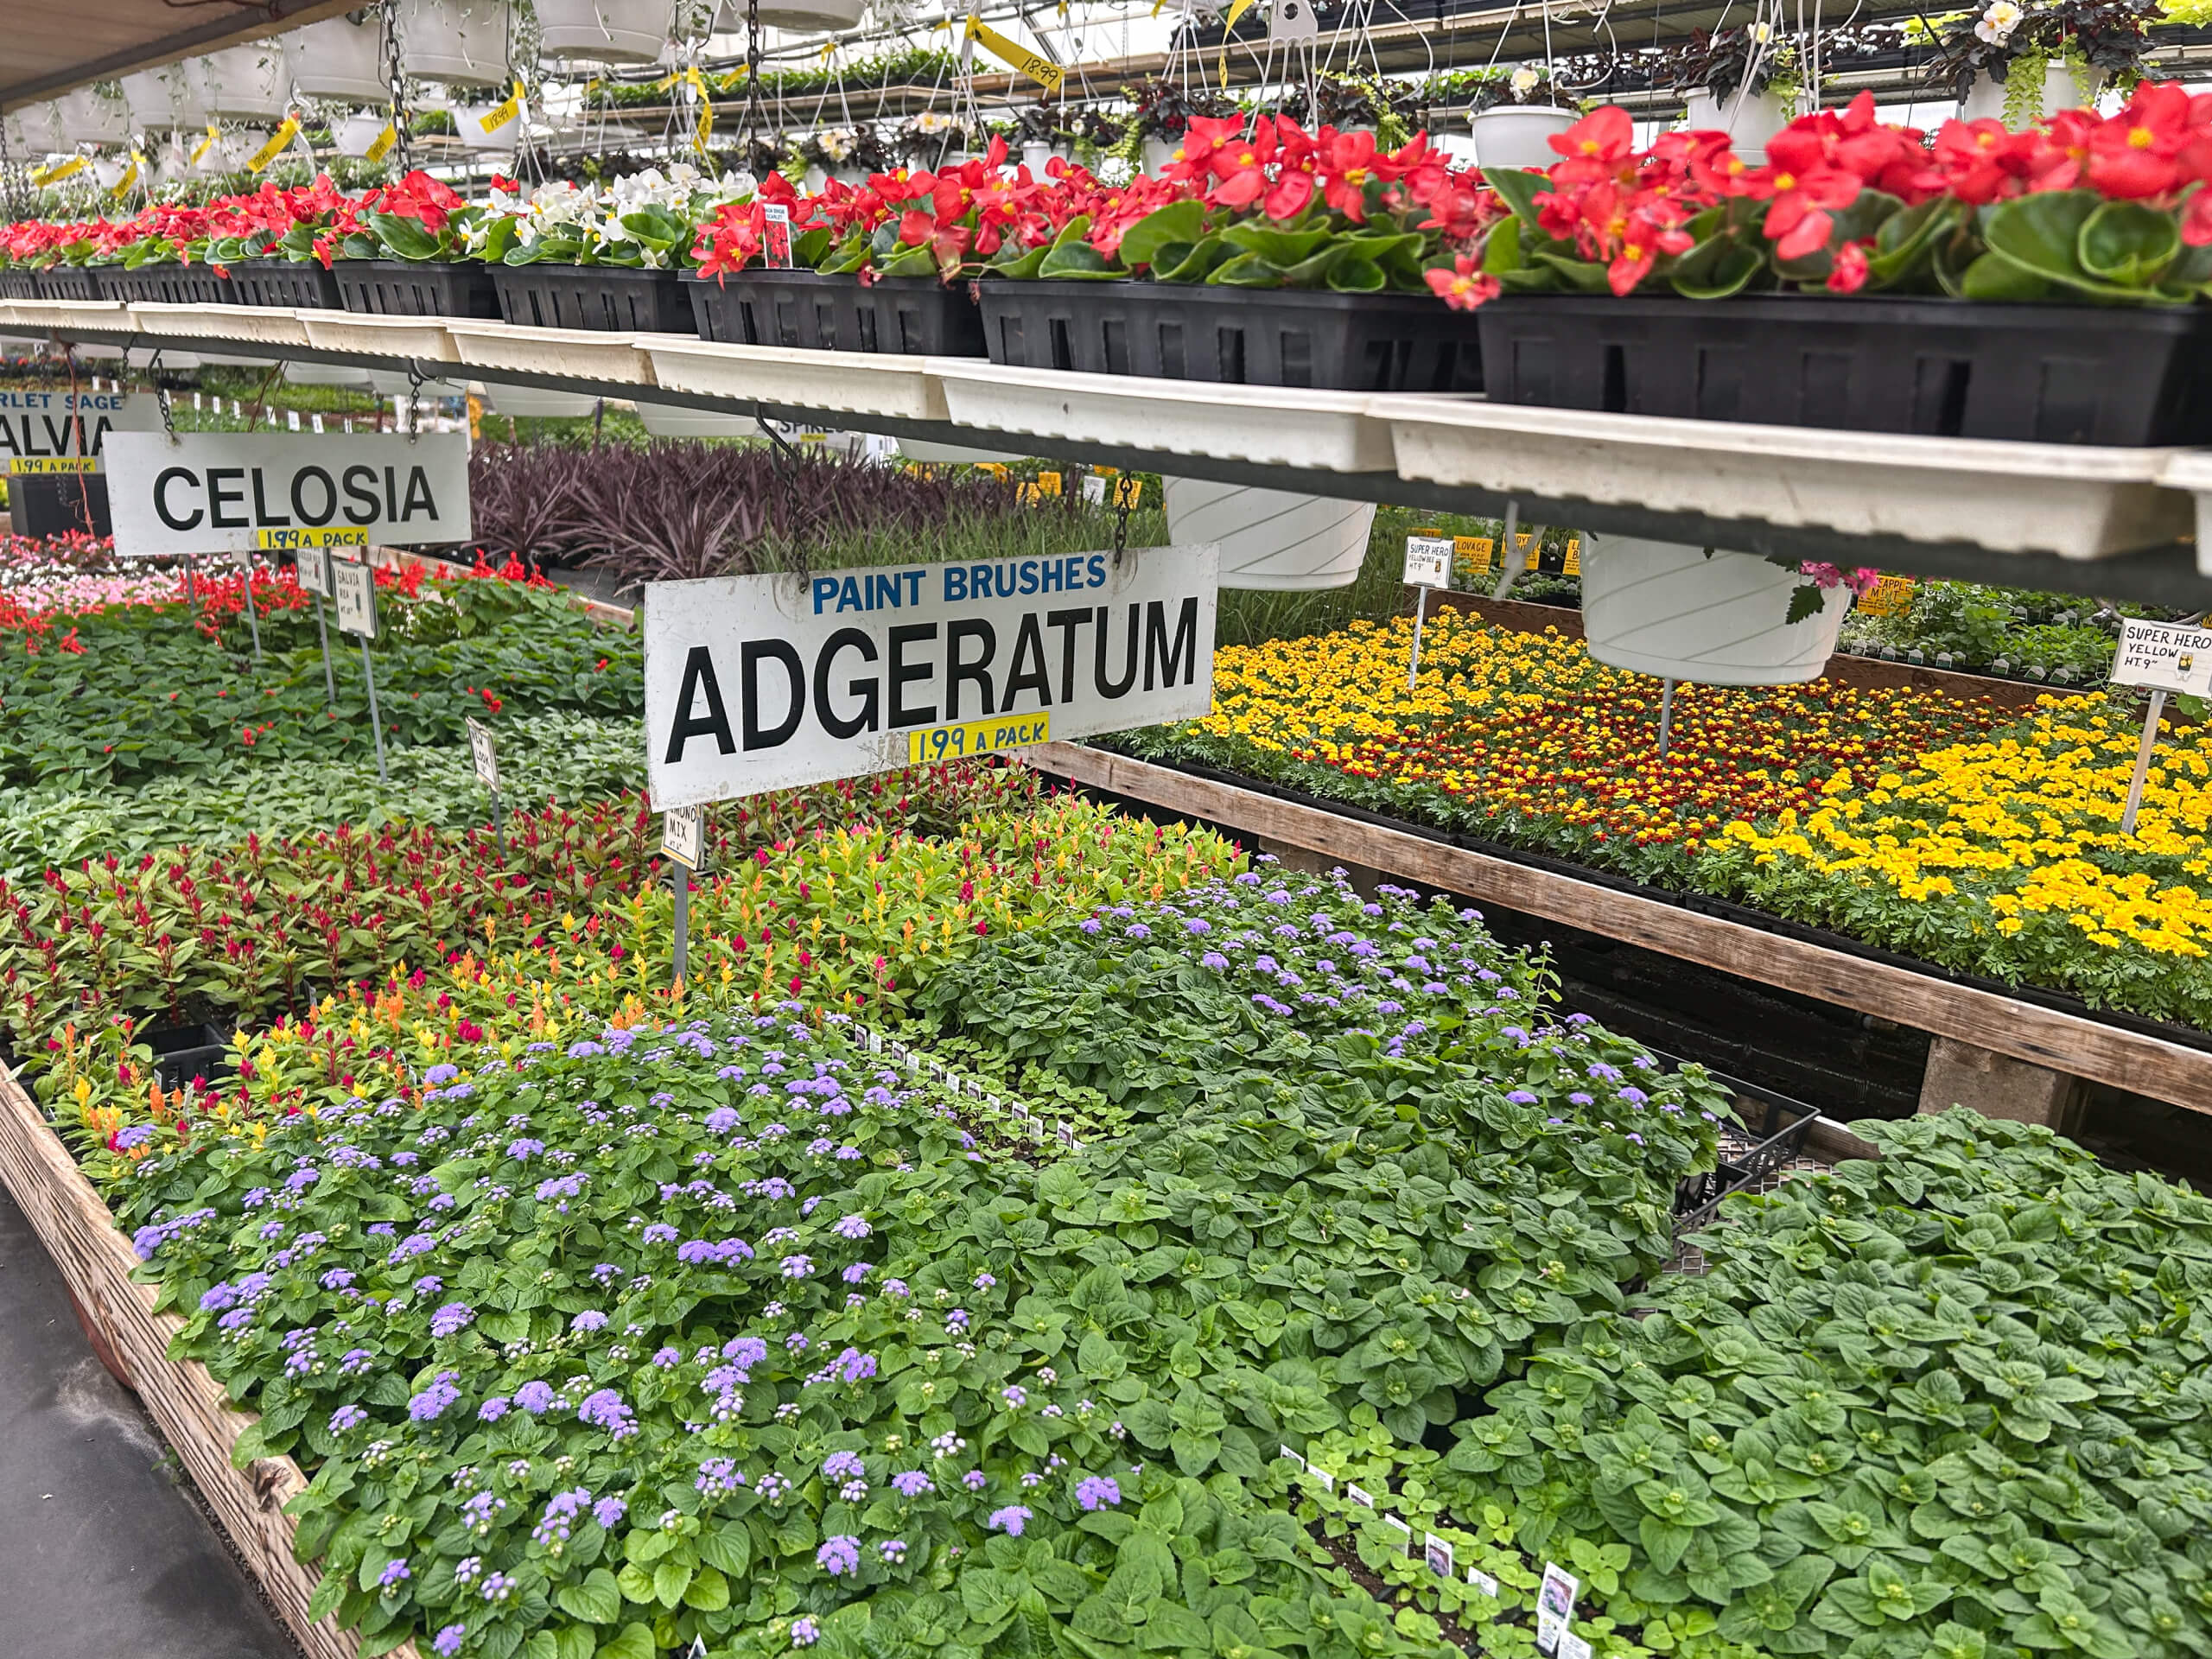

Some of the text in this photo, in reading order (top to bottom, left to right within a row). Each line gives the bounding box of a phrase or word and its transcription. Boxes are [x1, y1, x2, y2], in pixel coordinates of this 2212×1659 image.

[1021, 57, 1058, 85] 18.99
[65, 394, 123, 410] SAGE
[16, 459, 91, 473] 1.99 A PACK
[153, 465, 439, 531] CELOSIA
[267, 531, 366, 548] 1.99 A PACK
[1409, 543, 1430, 554] SUPER
[1456, 541, 1486, 553] LOVAGE
[337, 570, 360, 588] SALVIA
[813, 555, 1106, 614] PAINT BRUSHES
[2127, 626, 2212, 649] SUPER HERO
[2129, 643, 2178, 657] YELLOW
[664, 596, 1198, 764] ADGERATUM
[918, 721, 1047, 760] 1.99 A PACK
[669, 817, 687, 842] MIX
